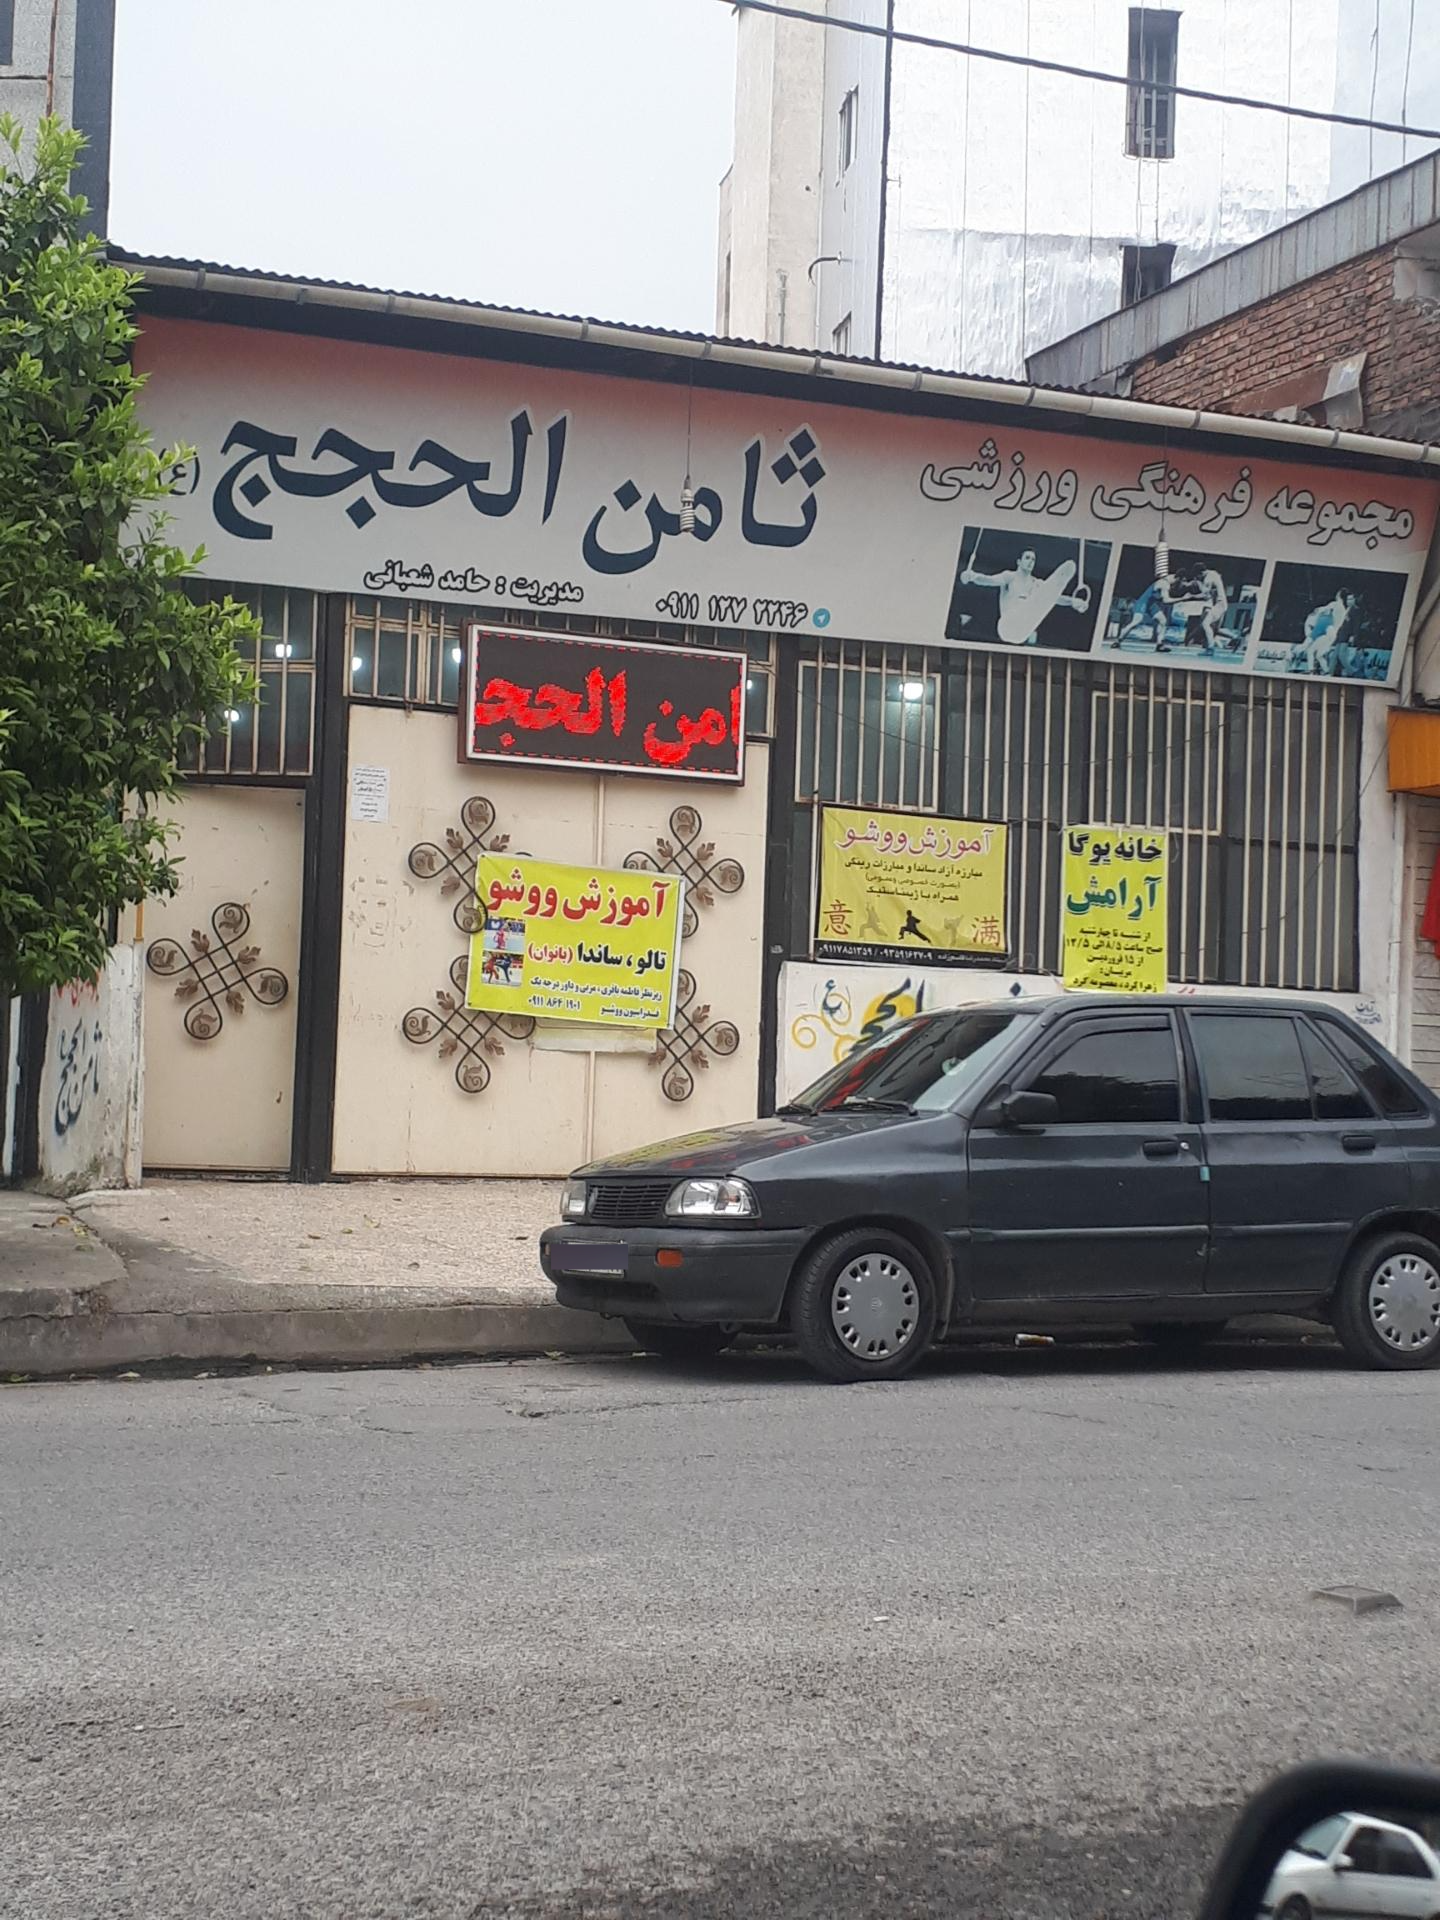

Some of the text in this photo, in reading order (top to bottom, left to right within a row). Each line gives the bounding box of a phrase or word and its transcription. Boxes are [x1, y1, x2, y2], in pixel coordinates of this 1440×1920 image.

[212, 409, 568, 540] الحجج
[581, 428, 827, 575] ثامن
[920, 438, 1415, 550] مجموعه فرهنگی ورزشی
[363, 559, 433, 591] شعبانی
[438, 567, 489, 593] حامد
[510, 575, 584, 605] مدیریت
[655, 591, 700, 619] ۰۹۱۱
[838, 820, 995, 860] آموزش ووشو
[1068, 831, 1163, 866] خانه یوگا
[486, 867, 671, 927] آموزش ووشو
[1066, 875, 1163, 921] آرامش
[823, 899, 854, 936] 意
[528, 942, 574, 965] (بانوان)
[577, 942, 623, 966] ساندا
[635, 949, 668, 975] تالو
